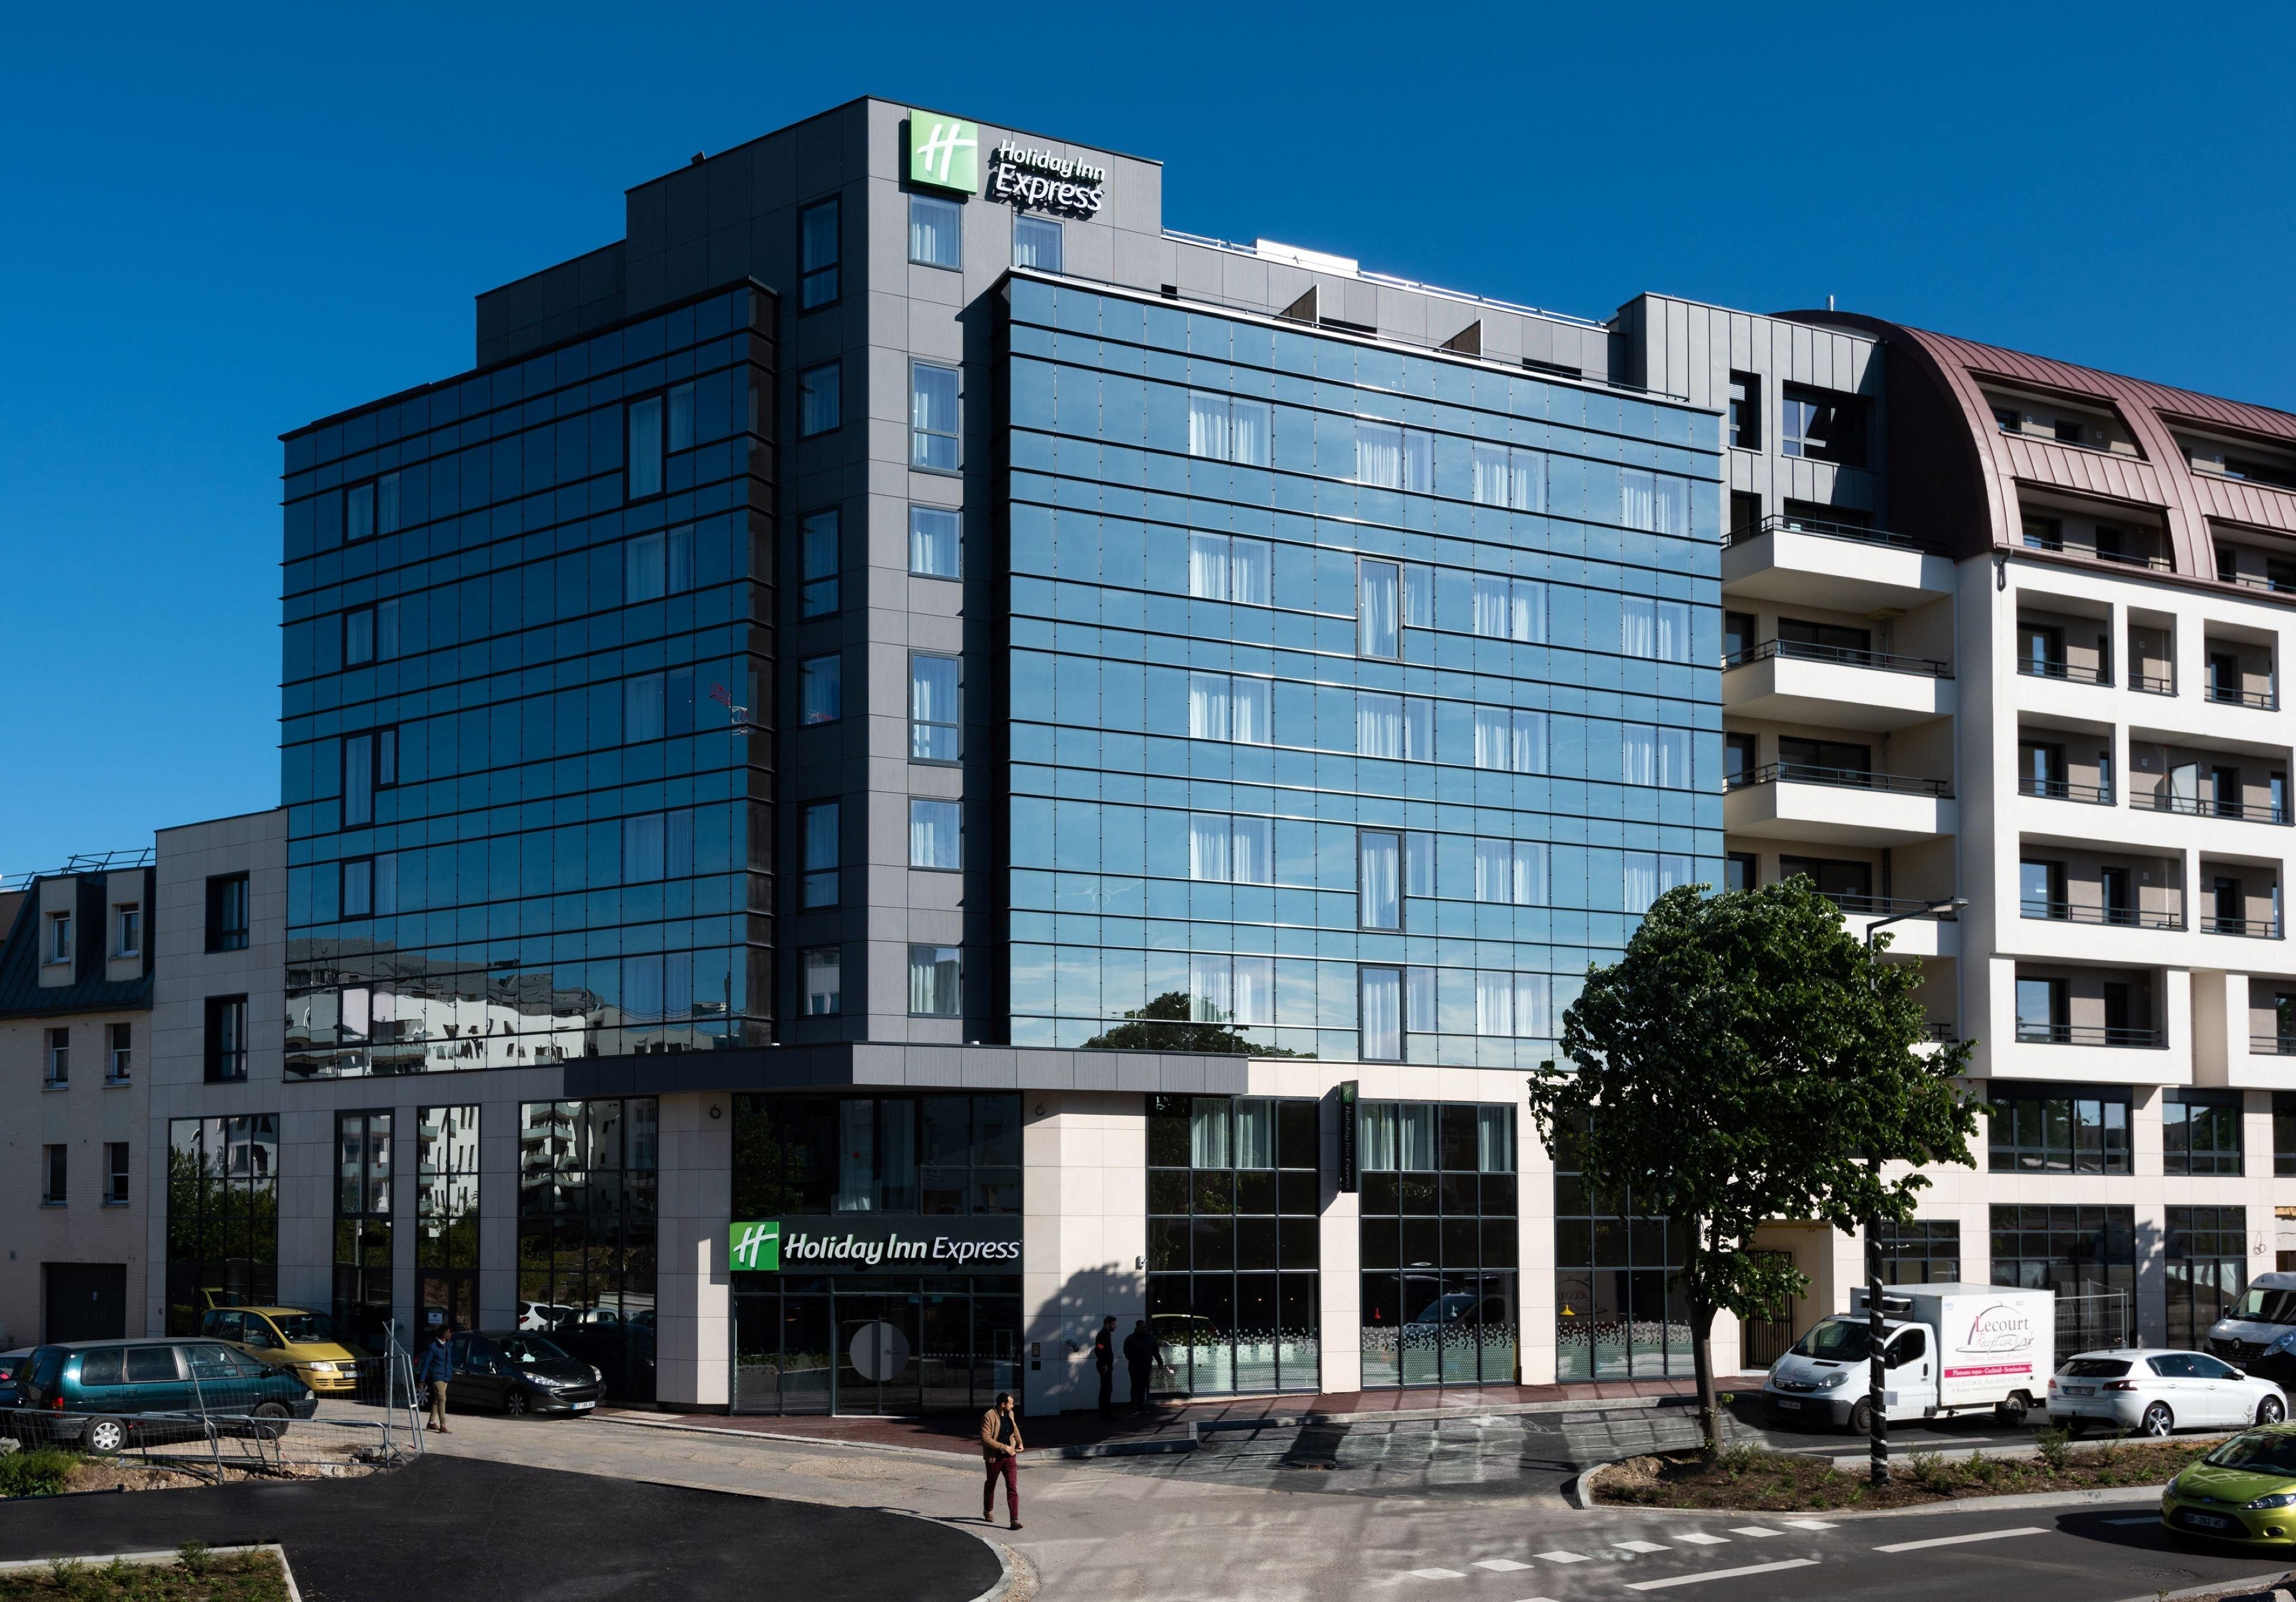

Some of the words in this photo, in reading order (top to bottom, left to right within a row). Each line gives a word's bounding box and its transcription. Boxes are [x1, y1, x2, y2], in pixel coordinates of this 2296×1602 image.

[999, 139, 1073, 176] Holiday
[1074, 156, 1106, 182] Inn
[996, 163, 1105, 212] Express
[784, 1233, 884, 1265] Holiday
[887, 1234, 927, 1259] Inn
[932, 1237, 1020, 1264] Express
[1975, 1316, 2029, 1332] Lecourt
